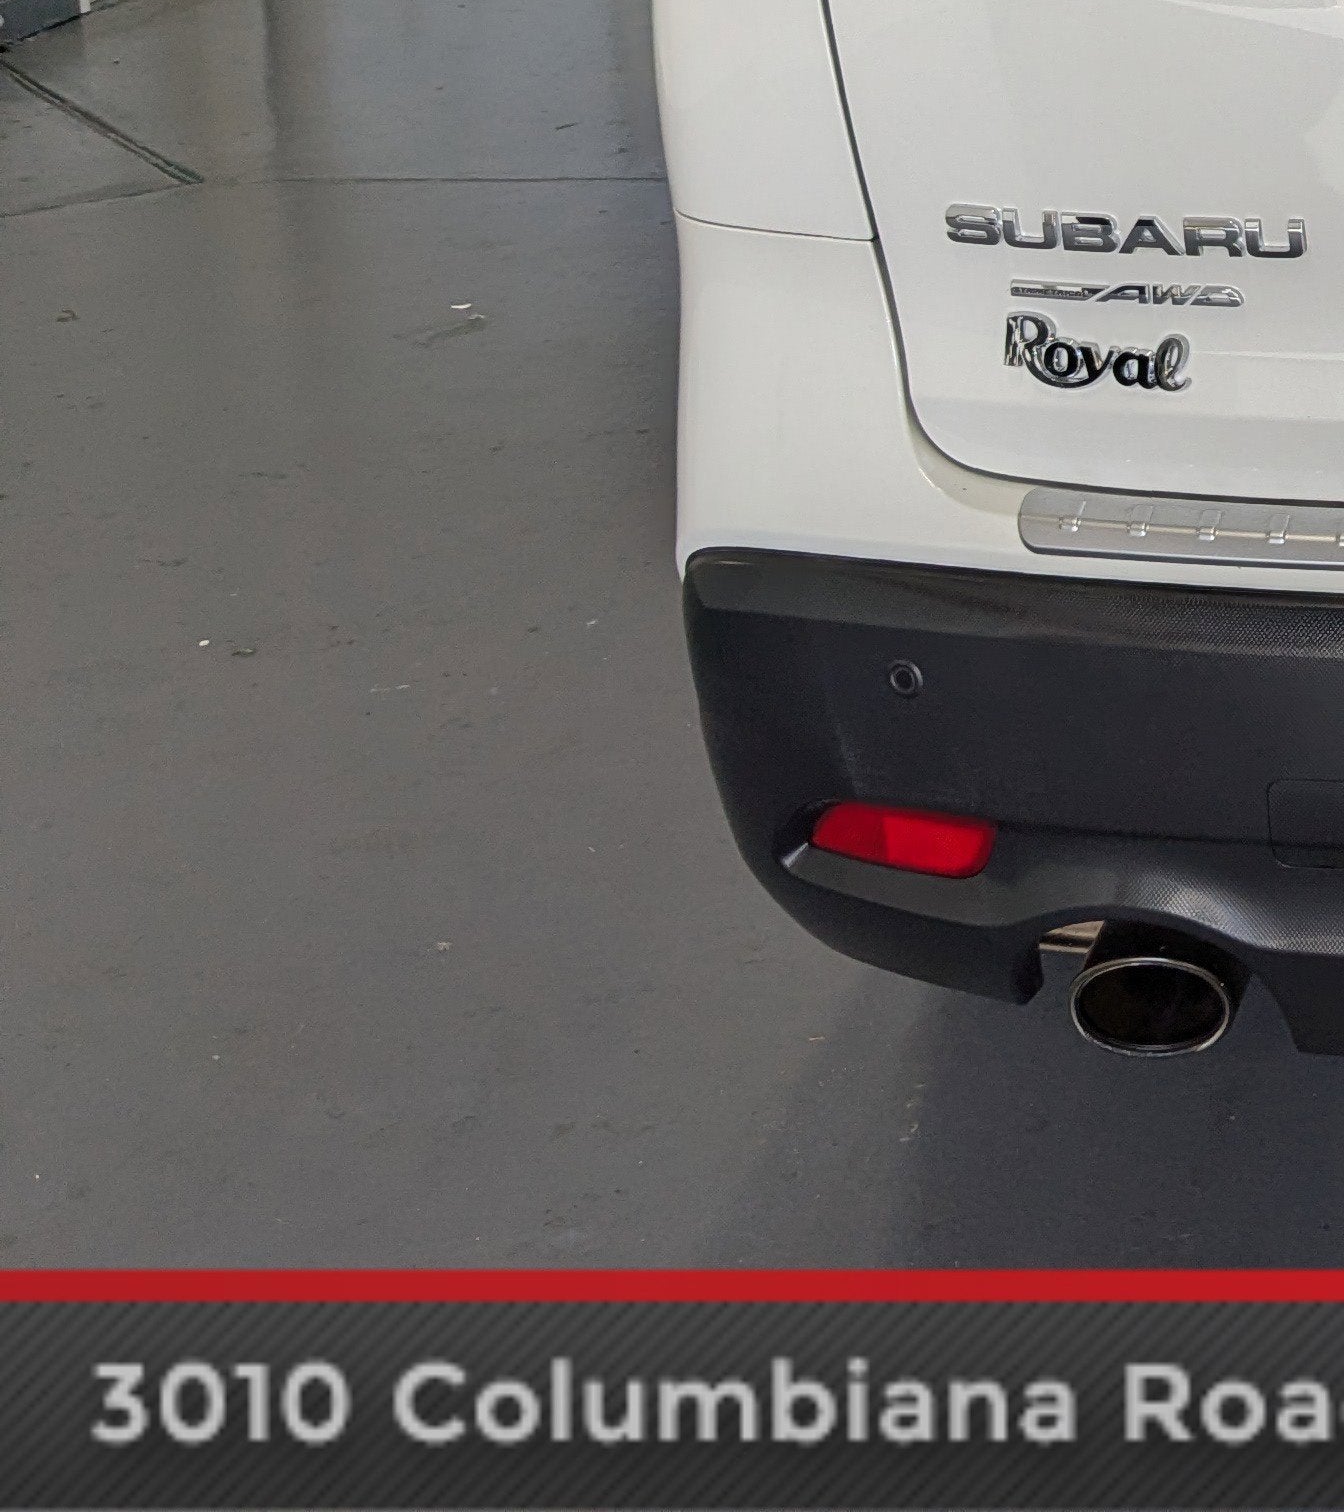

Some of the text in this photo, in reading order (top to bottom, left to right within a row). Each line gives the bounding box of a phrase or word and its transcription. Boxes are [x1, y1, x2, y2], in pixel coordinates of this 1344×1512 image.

[945, 203, 1308, 259] SUBARU
[1095, 282, 1246, 307] AWD
[1003, 311, 1192, 392] Royal
